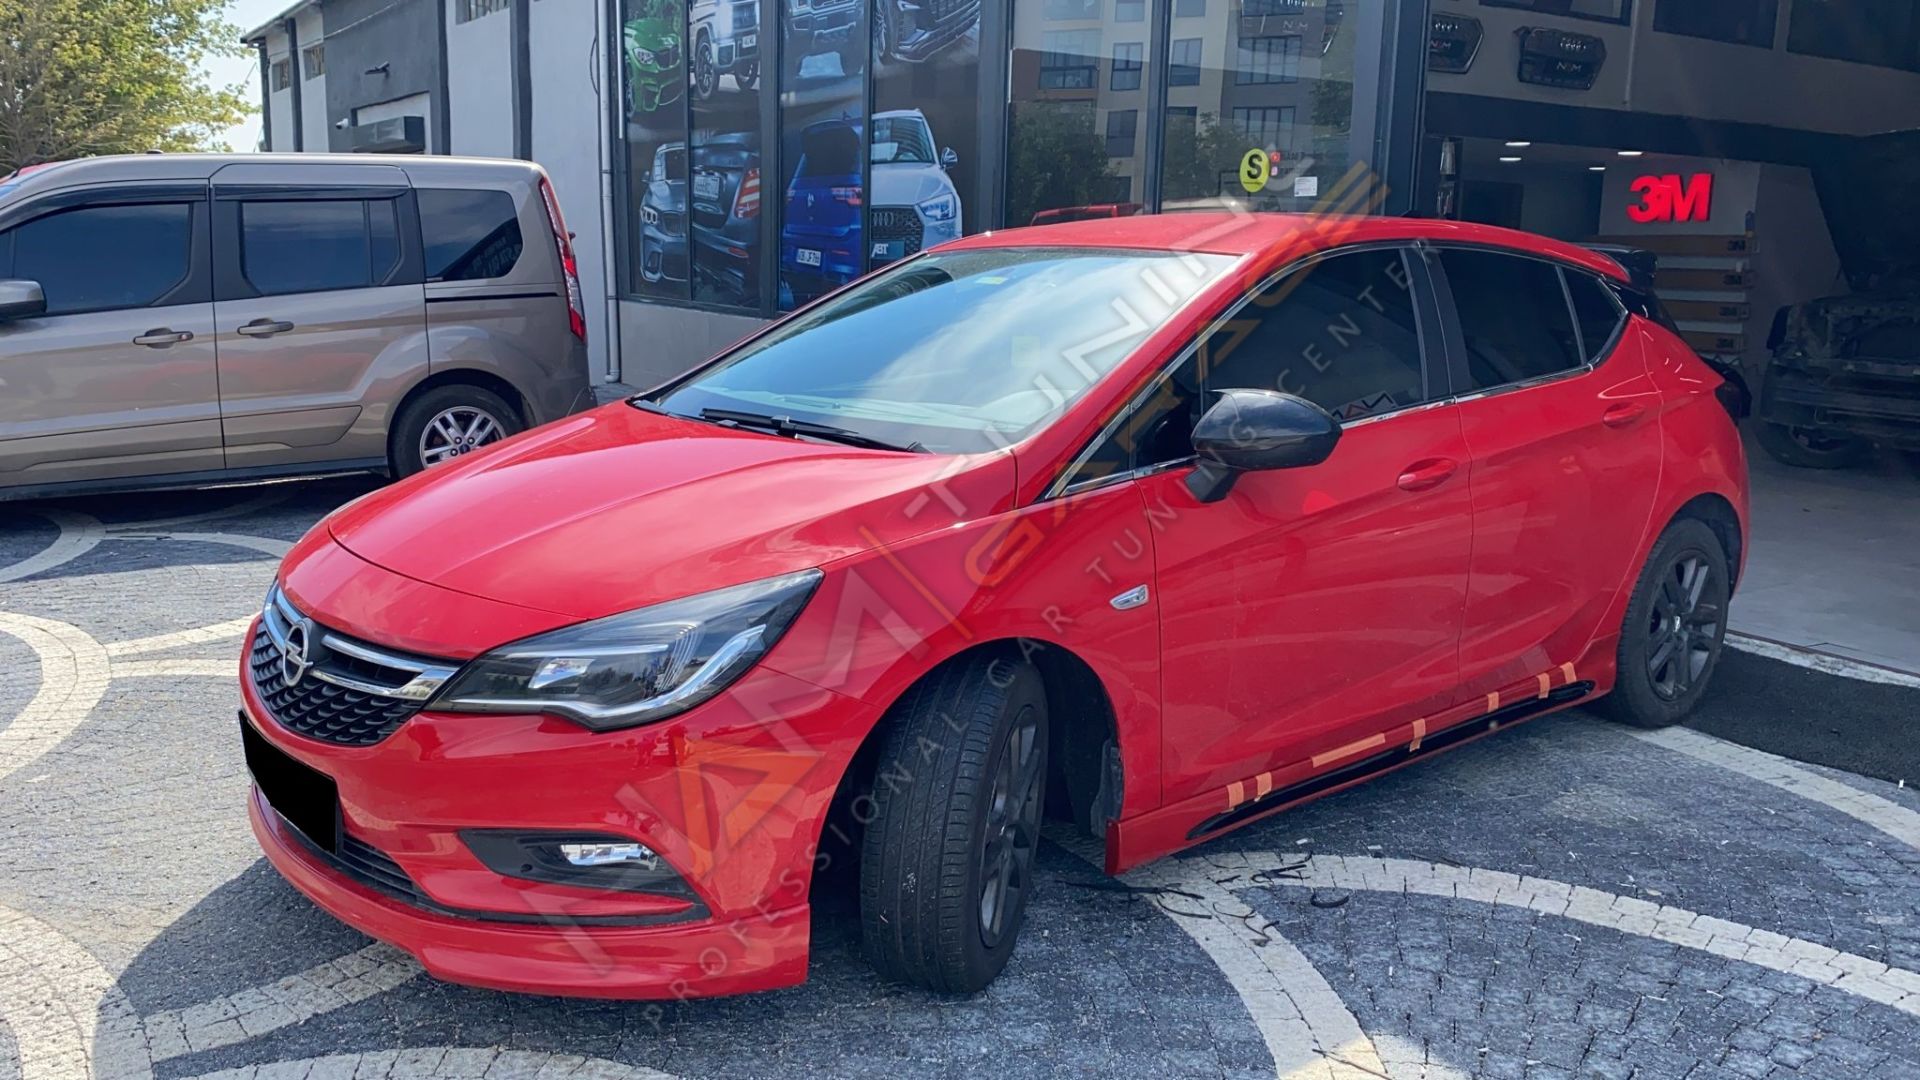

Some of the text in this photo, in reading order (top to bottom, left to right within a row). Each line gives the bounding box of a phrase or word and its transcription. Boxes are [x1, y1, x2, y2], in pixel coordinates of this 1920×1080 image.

[1247, 154, 1262, 179] S
[1627, 174, 1713, 223] 3M
[871, 243, 888, 258] ABT
